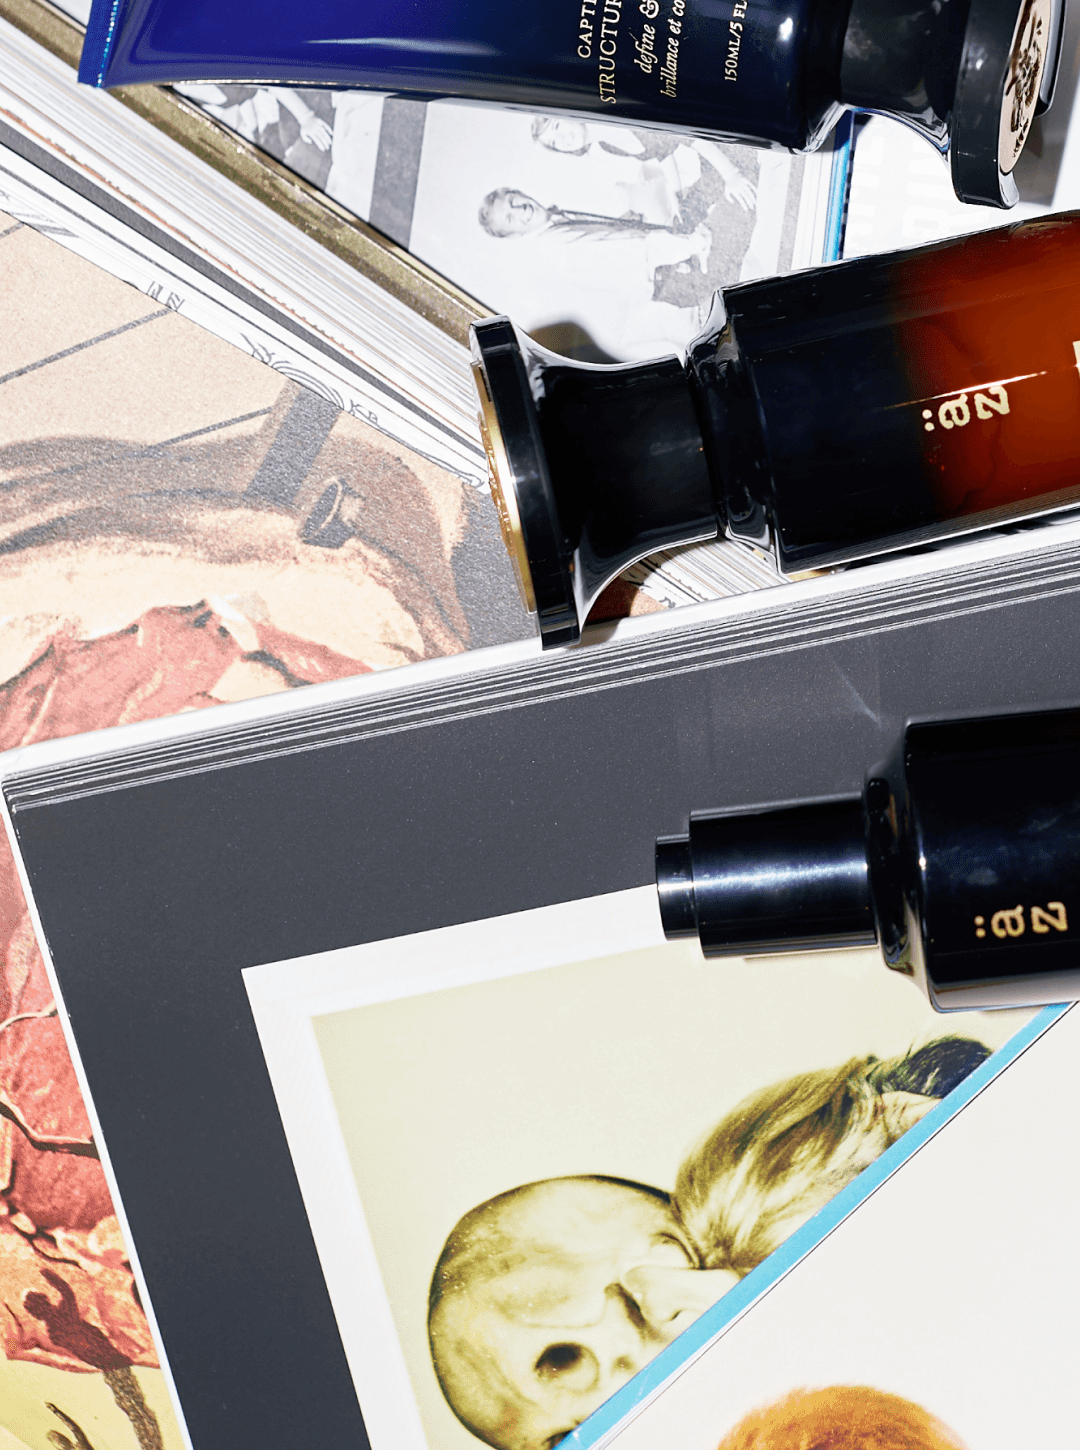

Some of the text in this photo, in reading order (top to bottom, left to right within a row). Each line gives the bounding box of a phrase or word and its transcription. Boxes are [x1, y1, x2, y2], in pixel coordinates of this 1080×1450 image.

[634, 24, 658, 73] define
[668, 19, 681, 34] et
[725, 21, 742, 81] 150ML/5
[660, 38, 679, 97] brillance
